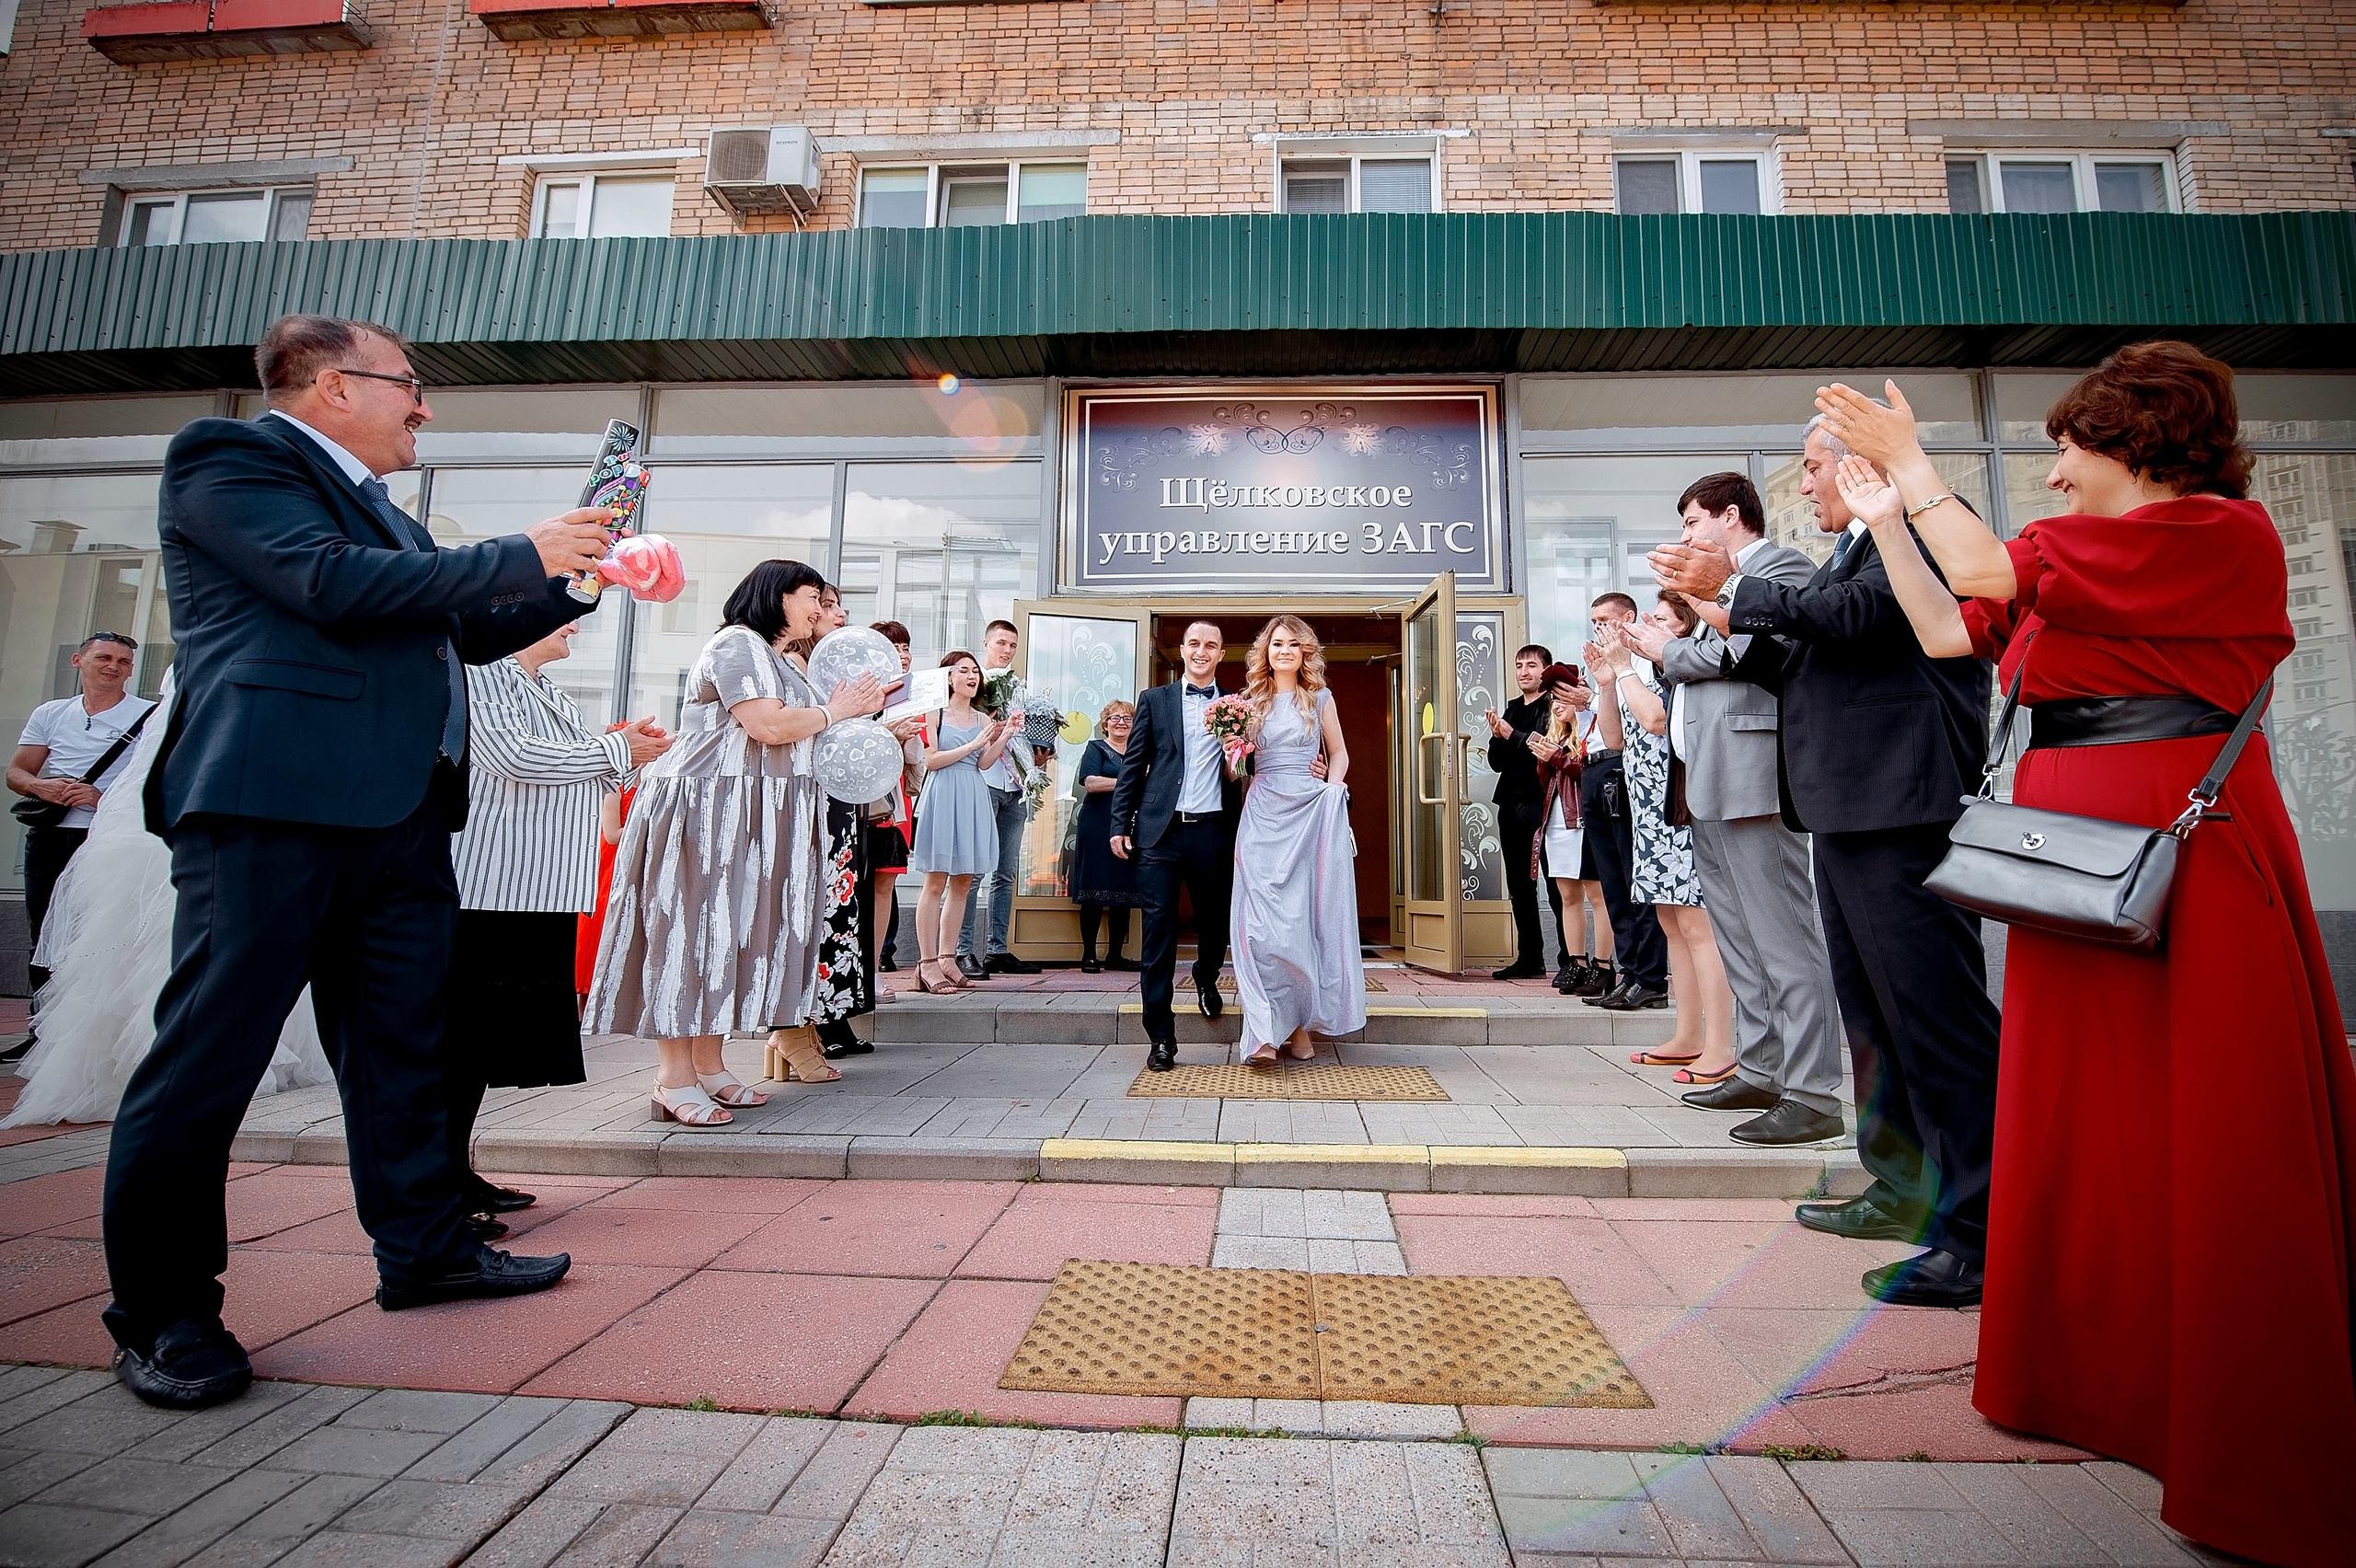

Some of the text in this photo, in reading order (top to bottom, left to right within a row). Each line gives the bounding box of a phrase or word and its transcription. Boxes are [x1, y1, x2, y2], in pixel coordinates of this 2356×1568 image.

[1160, 477, 1413, 513] Щёлковское
[1099, 521, 1476, 564] управление ЗАГС
